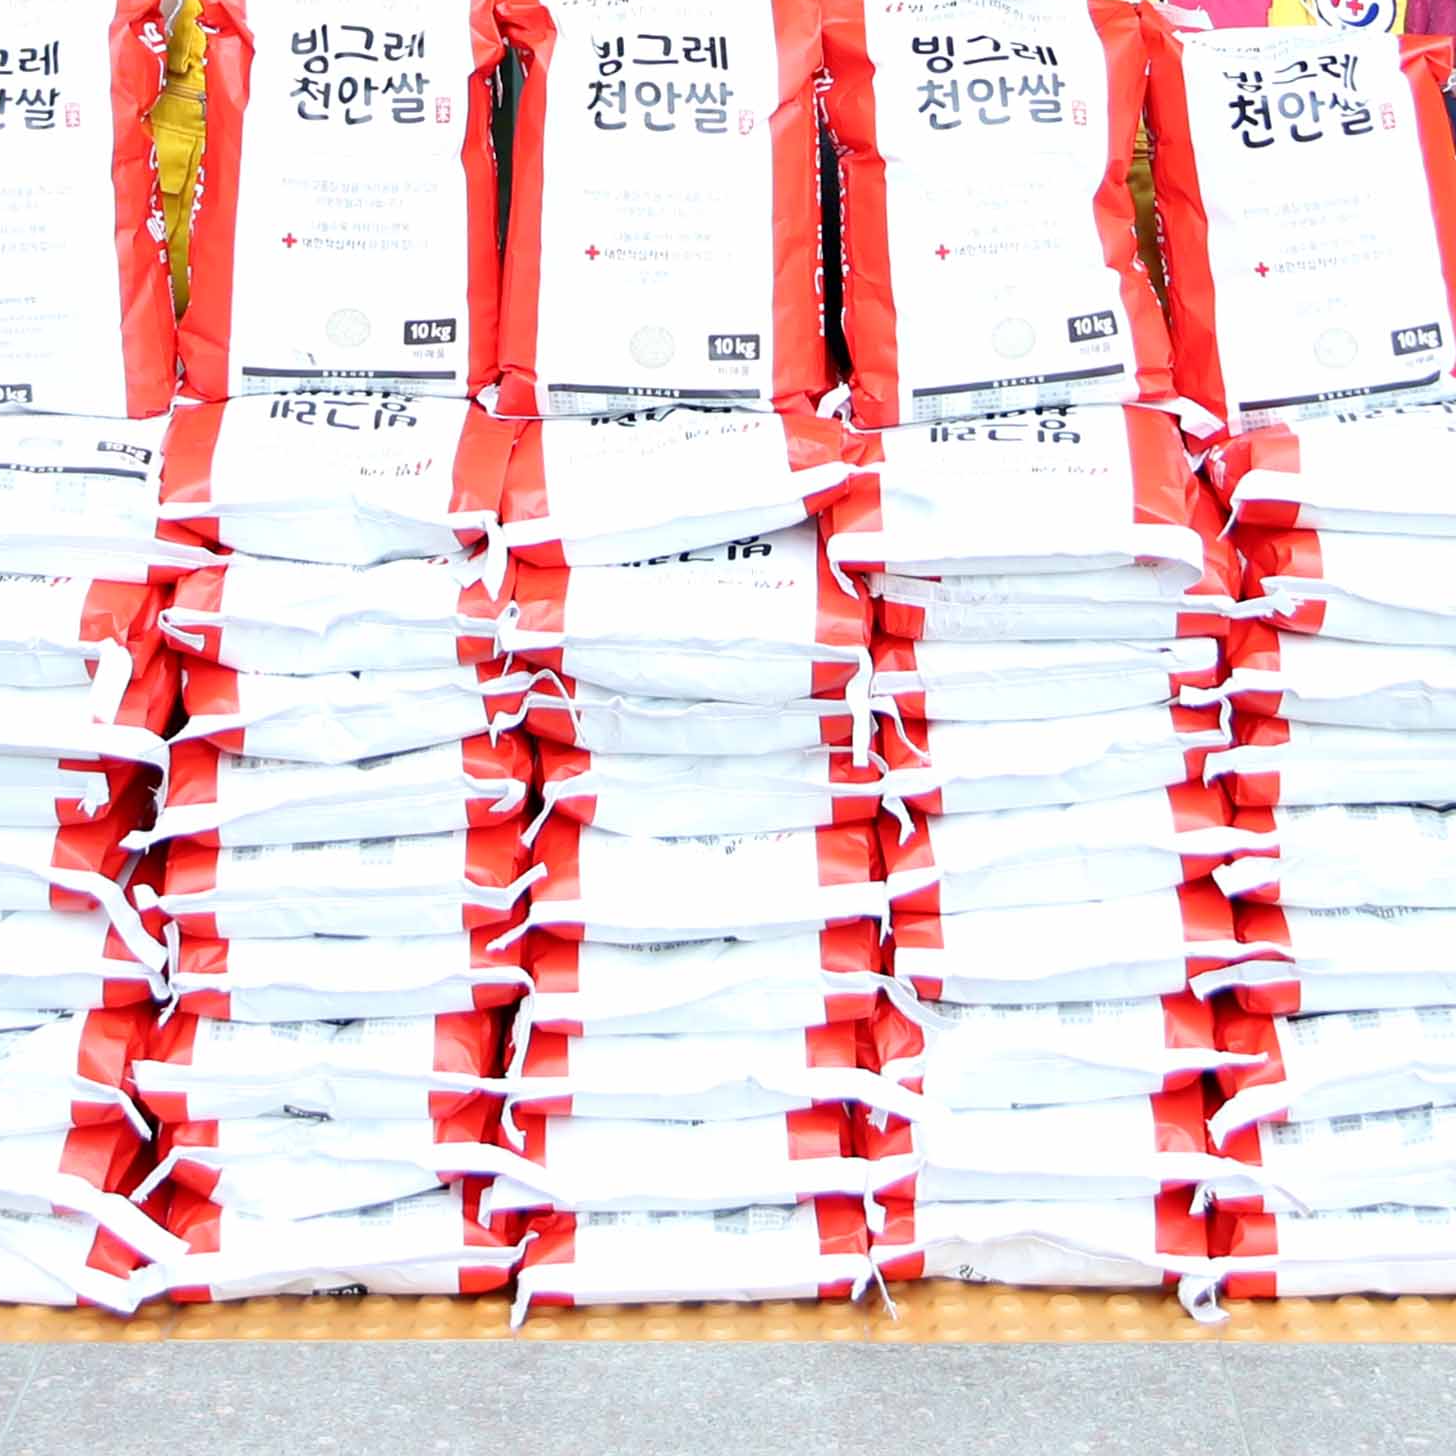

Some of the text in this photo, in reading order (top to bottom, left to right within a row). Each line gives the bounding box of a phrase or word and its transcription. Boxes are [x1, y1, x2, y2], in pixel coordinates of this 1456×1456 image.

[291, 24, 425, 75] 빙그레
[591, 34, 728, 75] 빙그레
[912, 34, 1058, 74] 빙그레
[1223, 54, 1359, 92] 빙그레
[290, 72, 430, 125] 천안쌀
[587, 80, 734, 134] 천안쌀
[917, 73, 1066, 131] 천안쌀
[1230, 89, 1375, 150] 천안쌀
